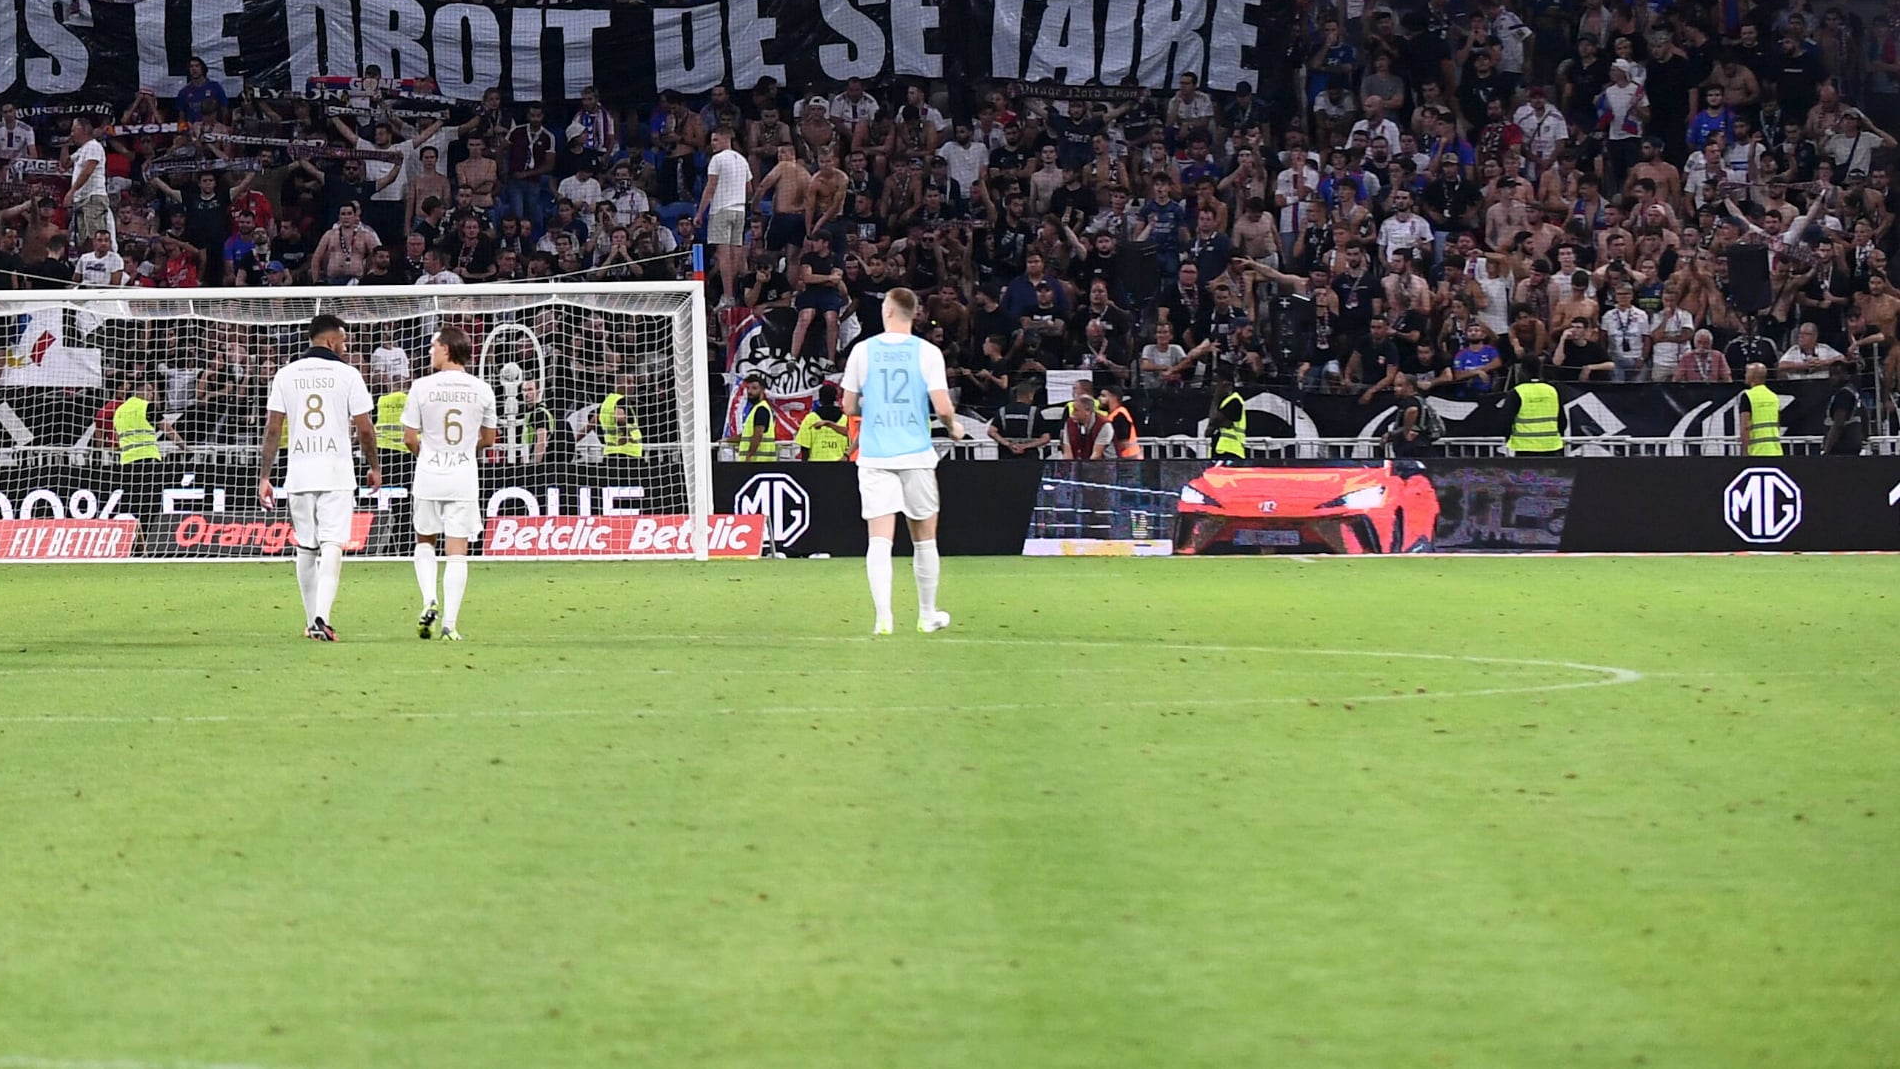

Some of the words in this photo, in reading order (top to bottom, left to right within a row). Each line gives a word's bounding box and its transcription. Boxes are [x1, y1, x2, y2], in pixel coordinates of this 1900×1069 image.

[114, 121, 179, 137] LYON
[293, 378, 335, 390] TOLISSO
[429, 391, 479, 405] CAQUERET
[880, 368, 910, 404] 12
[303, 393, 325, 430] 8
[443, 408, 463, 446] 6
[739, 479, 804, 542] MG
[1731, 476, 1798, 537] MG
[8, 527, 44, 558] FLY
[46, 526, 124, 557] BETTER
[489, 516, 611, 551] Betclic
[628, 516, 751, 551] Betlic
